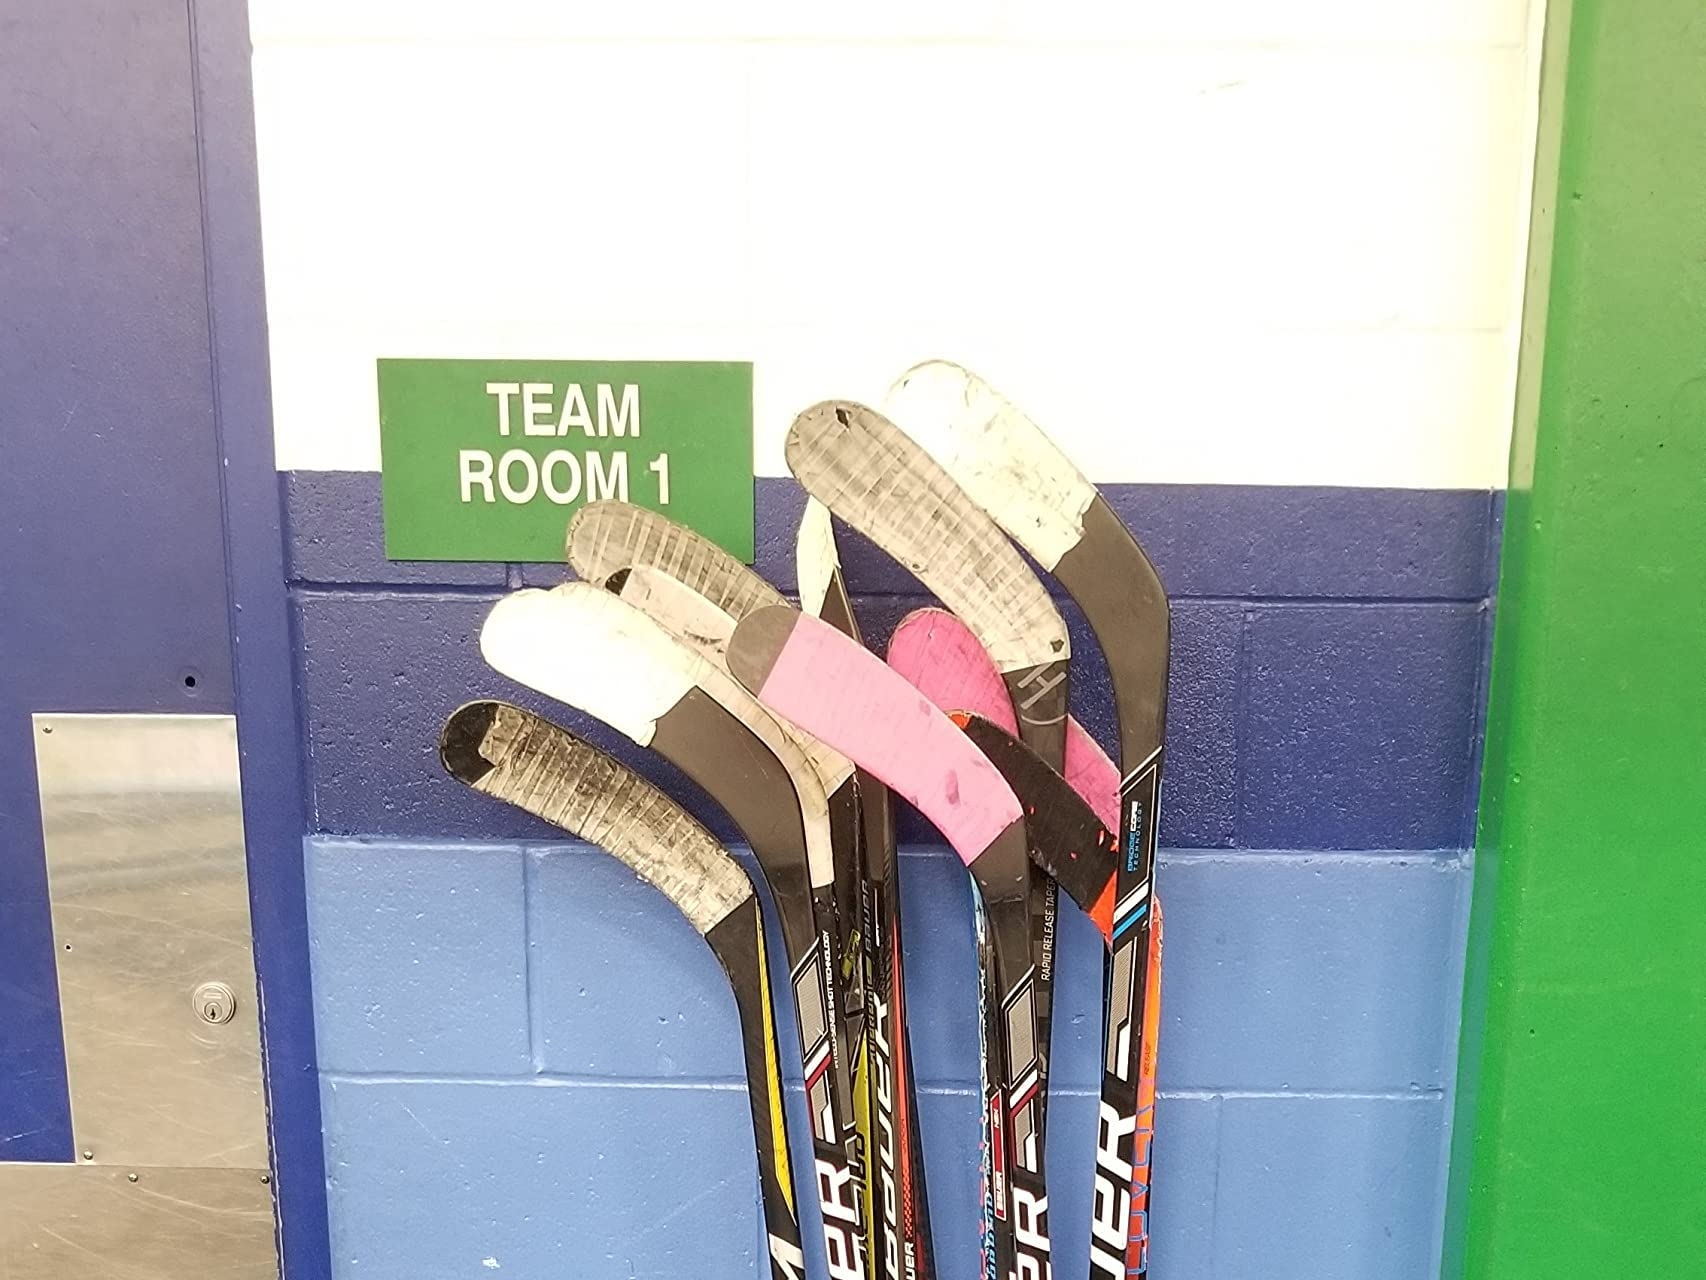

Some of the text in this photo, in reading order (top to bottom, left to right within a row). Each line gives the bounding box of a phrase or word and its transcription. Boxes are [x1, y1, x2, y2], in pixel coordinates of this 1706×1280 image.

[486, 382, 641, 438] TEAM
[458, 449, 670, 505] ROOM 1
[1133, 802, 1143, 872] TECHNOLOGY
[1041, 879, 1056, 982] RAPID RELEASE TAPER
